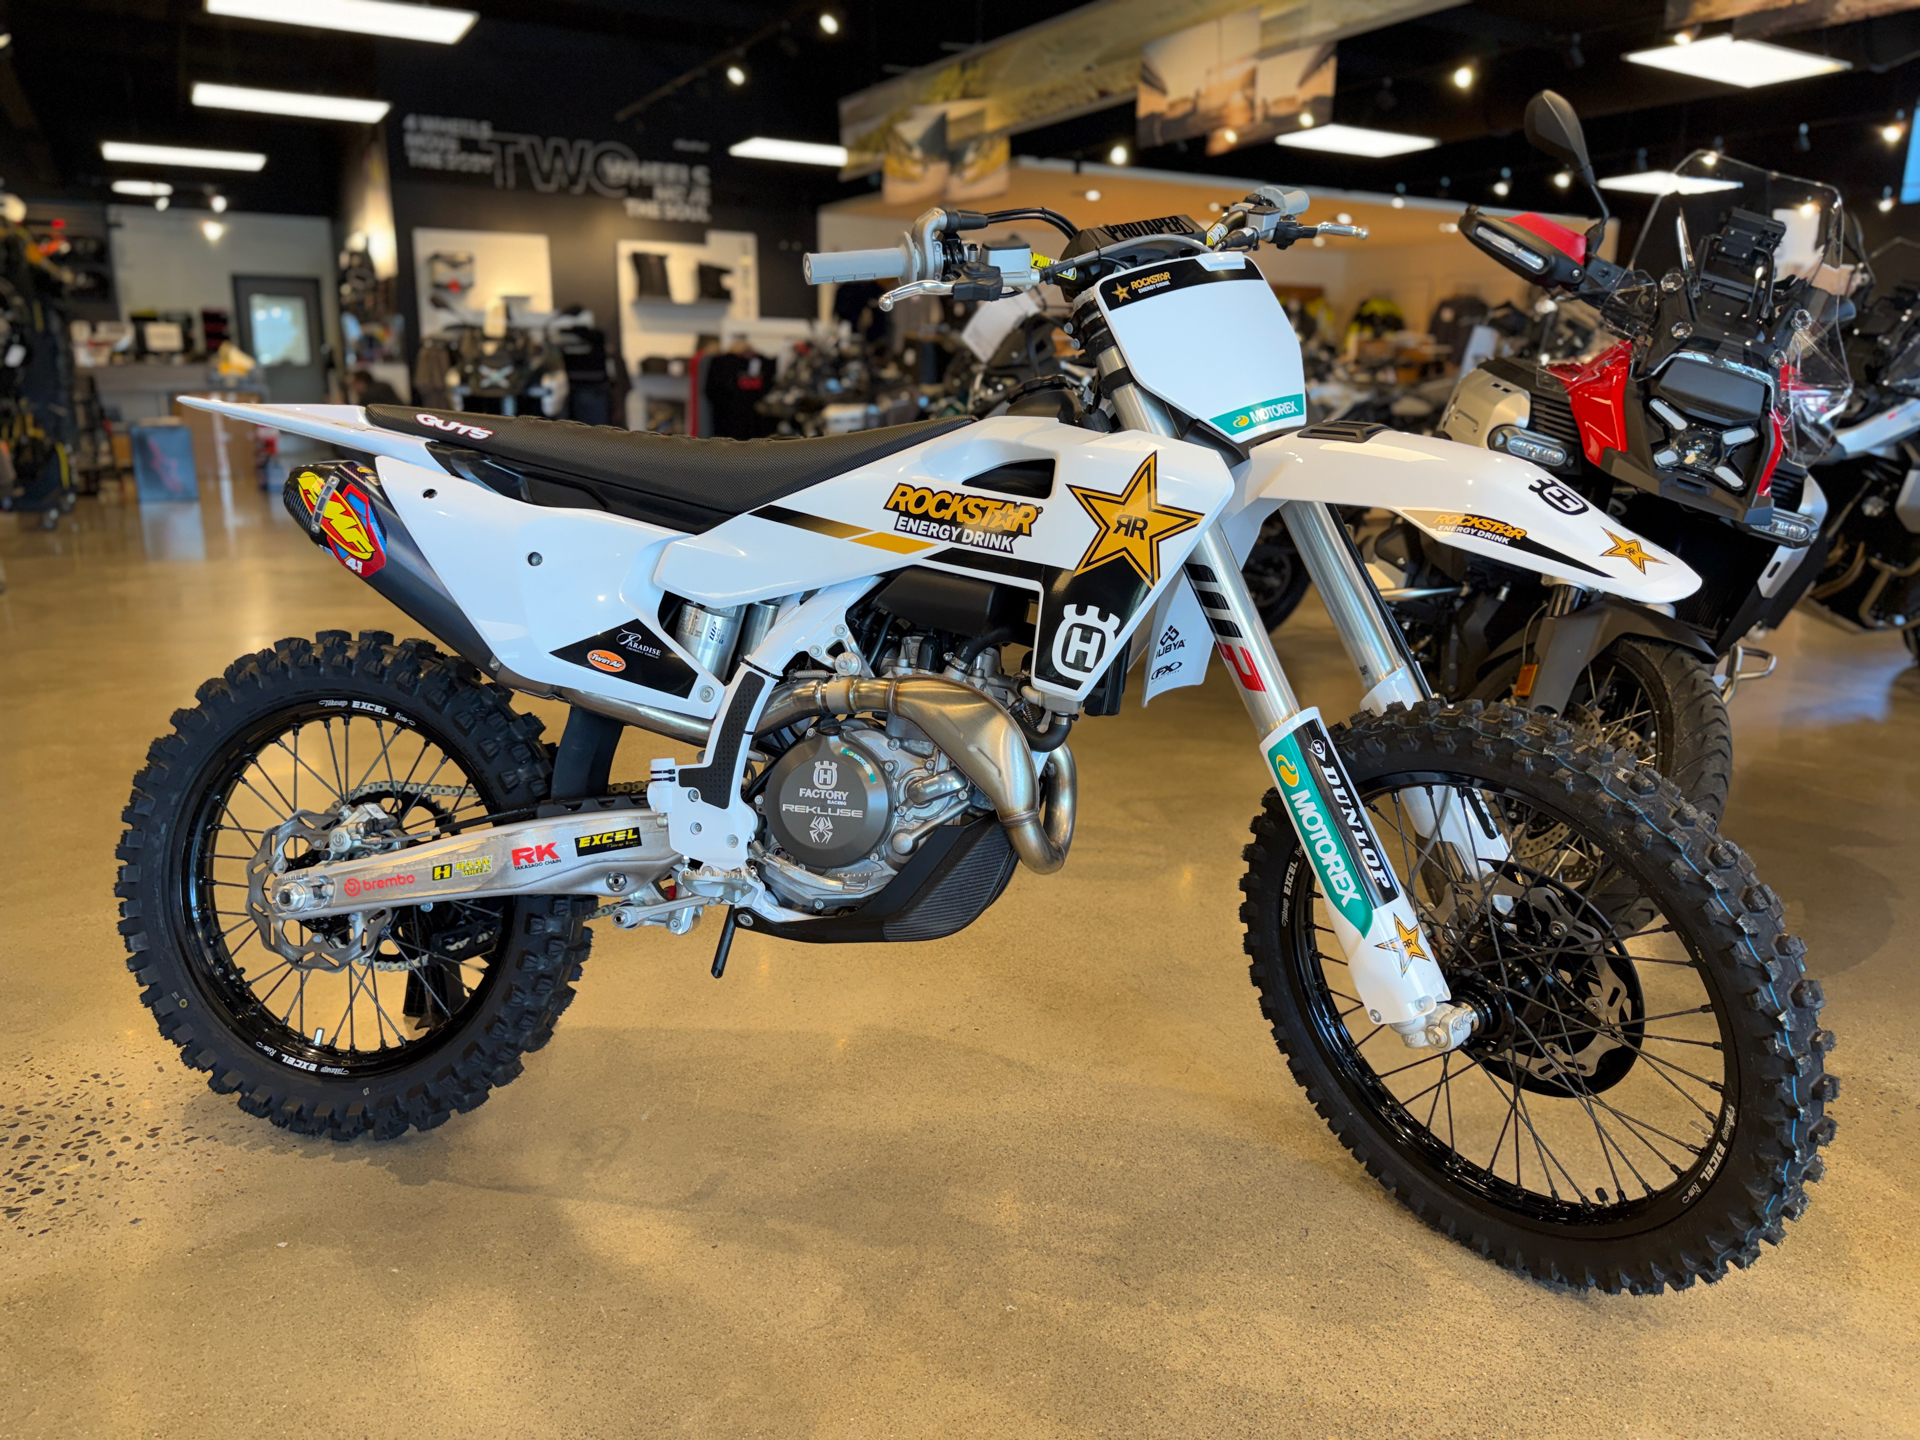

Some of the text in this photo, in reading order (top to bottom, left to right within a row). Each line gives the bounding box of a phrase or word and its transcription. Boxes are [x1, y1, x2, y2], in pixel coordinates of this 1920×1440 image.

[1130, 272, 1171, 290] ROCKSTAR
[1249, 401, 1299, 423] MOTOREX
[416, 413, 493, 440] GUTS
[884, 483, 1040, 536] ROCKSTAR
[895, 516, 1014, 551] ENERGY DRINK
[1433, 514, 1527, 541] ROCKSTAR
[1437, 525, 1511, 545] ENERGY DRINK
[351, 700, 389, 716] EXCEL
[799, 787, 849, 801] FACTORY
[782, 803, 864, 818] REKLUSE
[578, 828, 638, 848] EXCEL
[1320, 764, 1391, 890] DUNLOP
[511, 841, 560, 867] RK
[1289, 790, 1363, 908] MOTOREX
[514, 858, 562, 871] TAKASAGO CHAIN
[362, 873, 416, 891] brembo
[1283, 861, 1299, 896] EXCEL
[281, 1053, 318, 1072] EXCEL
[1700, 1141, 1727, 1182] EXCEL
